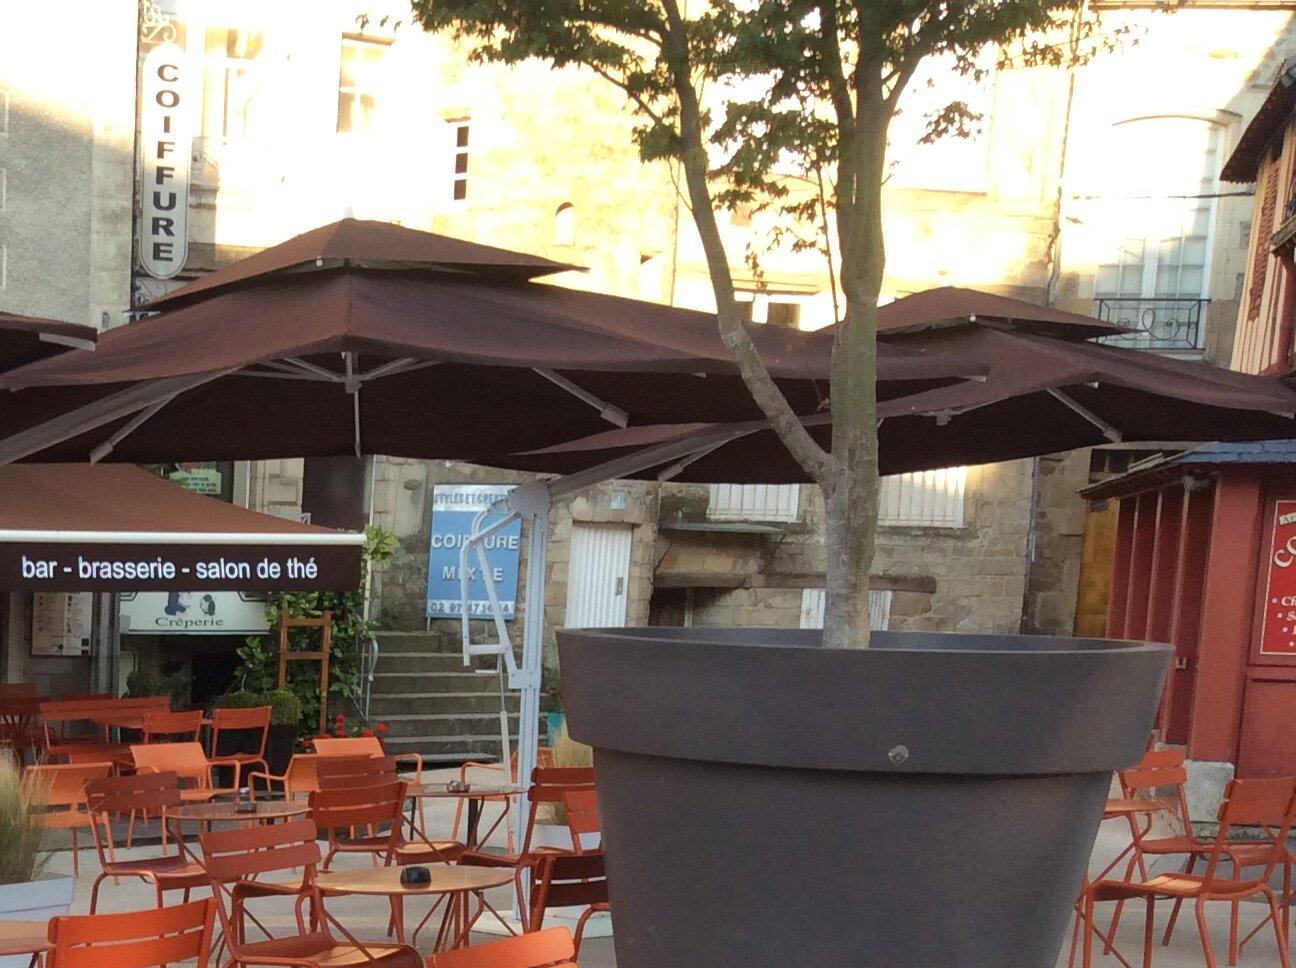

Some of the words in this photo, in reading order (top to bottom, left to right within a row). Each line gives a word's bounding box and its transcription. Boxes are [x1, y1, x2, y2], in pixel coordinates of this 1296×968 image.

[151, 64, 181, 262] COIFFURE
[431, 533, 519, 550] COIFURE
[21, 555, 57, 579] bar
[78, 556, 176, 580] brasserie
[196, 556, 251, 580] salon
[257, 557, 281, 580] de
[287, 556, 318, 580] thé
[155, 617, 224, 629] Crêperie
